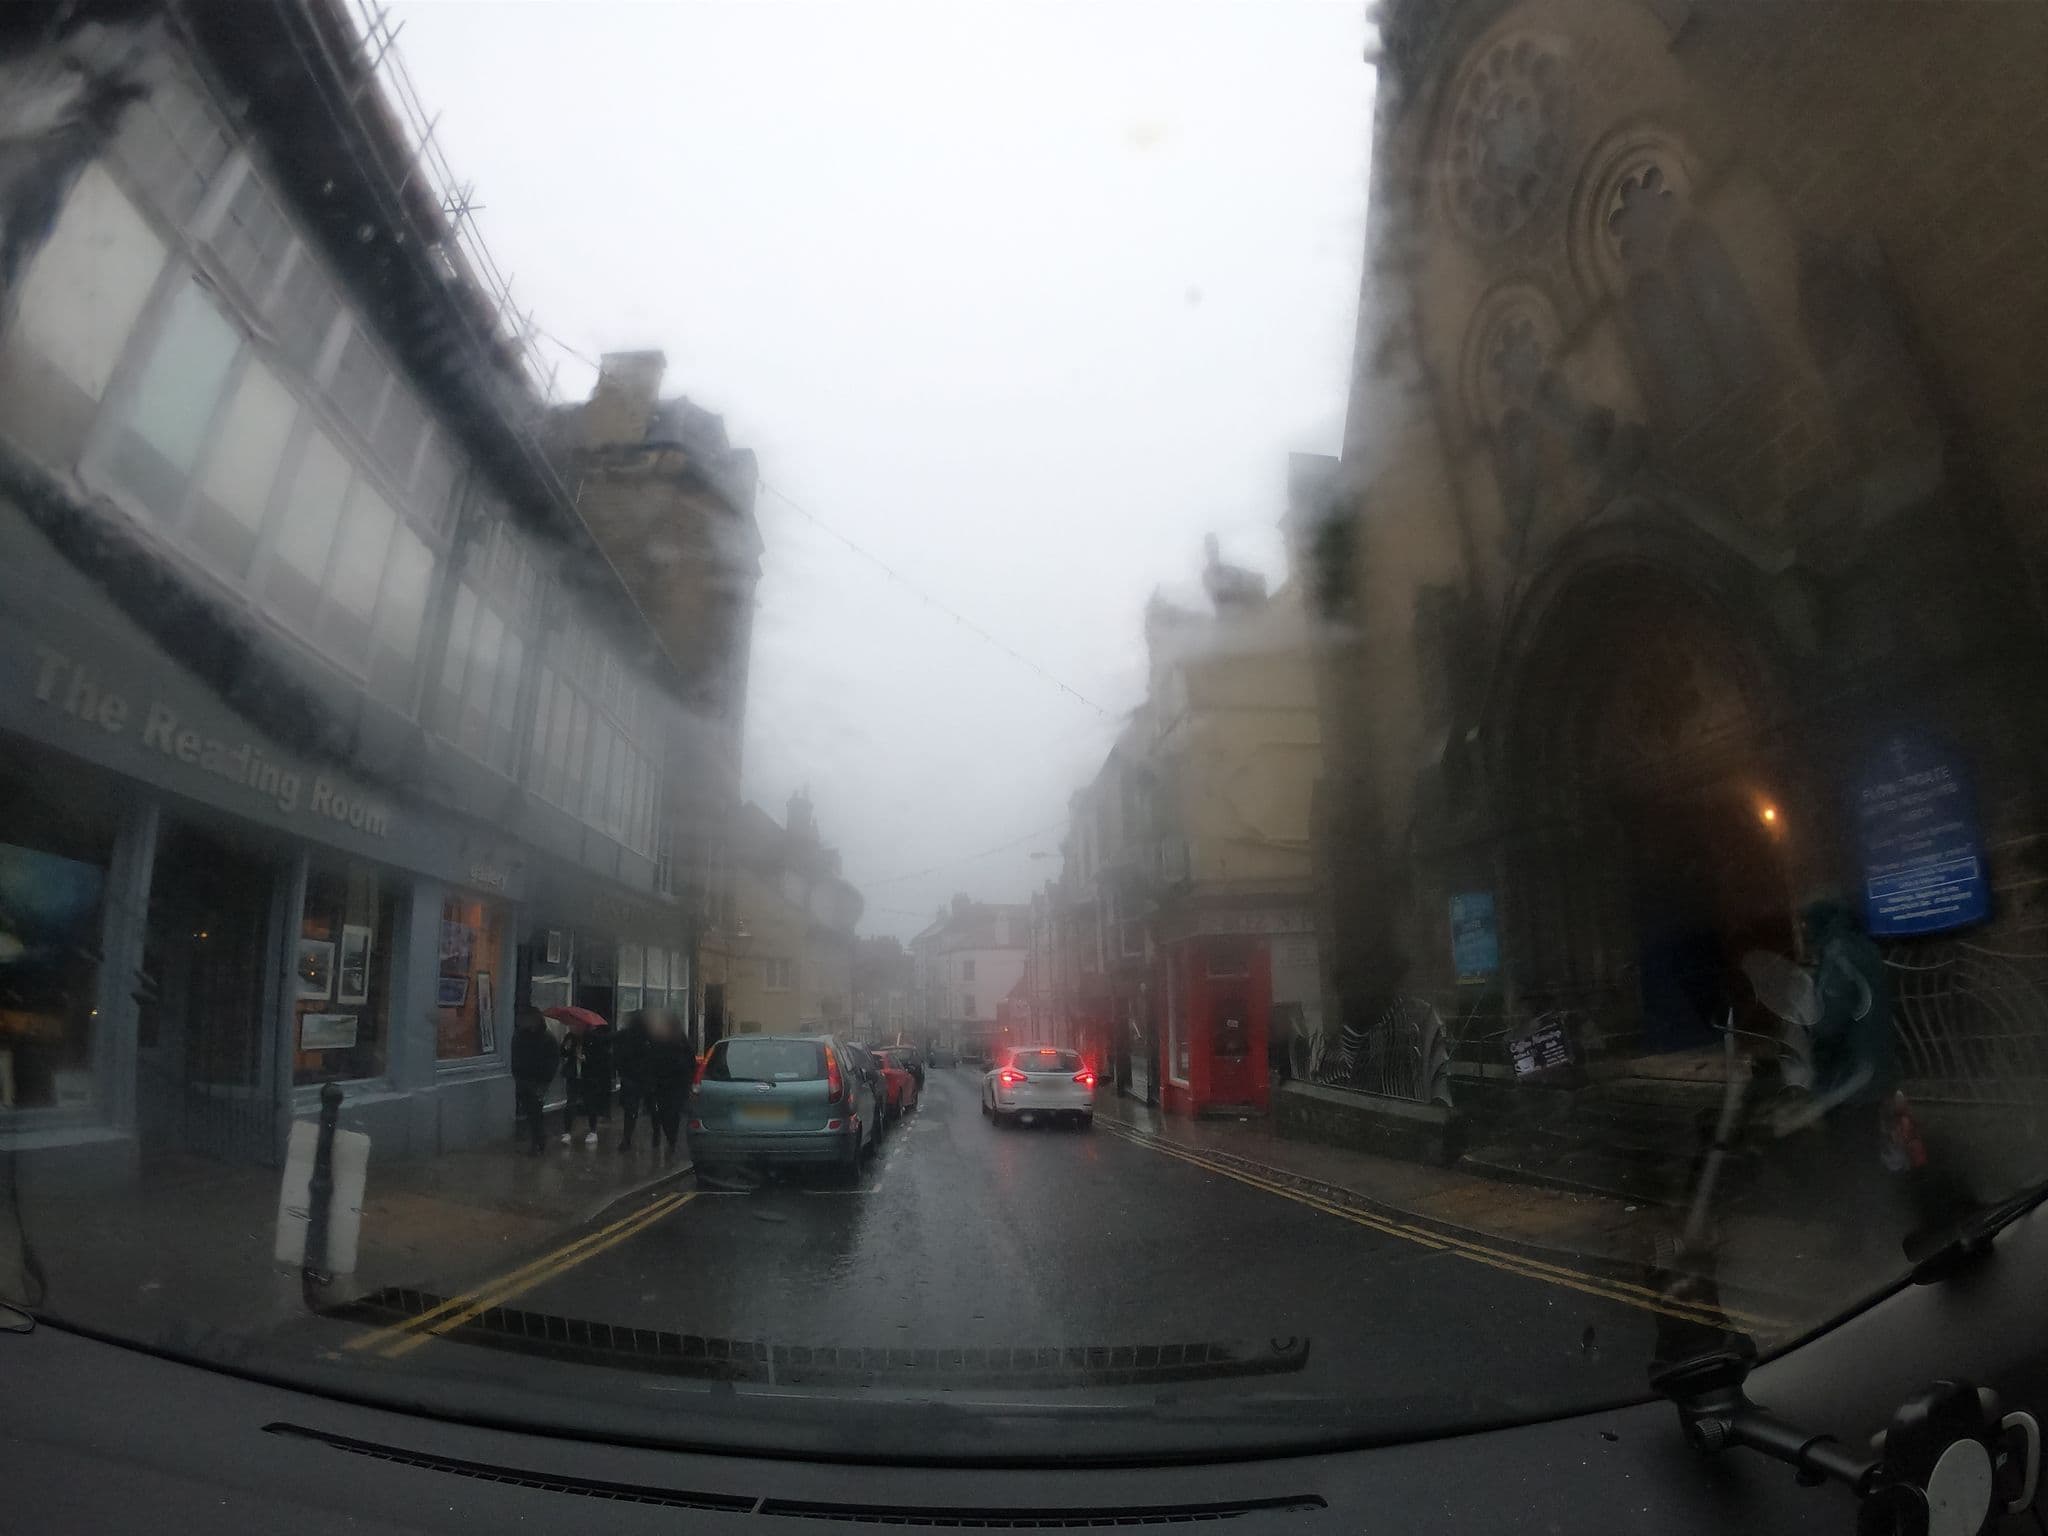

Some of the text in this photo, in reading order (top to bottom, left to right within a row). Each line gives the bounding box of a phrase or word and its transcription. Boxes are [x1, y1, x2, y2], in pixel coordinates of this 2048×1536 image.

[33, 650, 386, 836] The Reading Room
